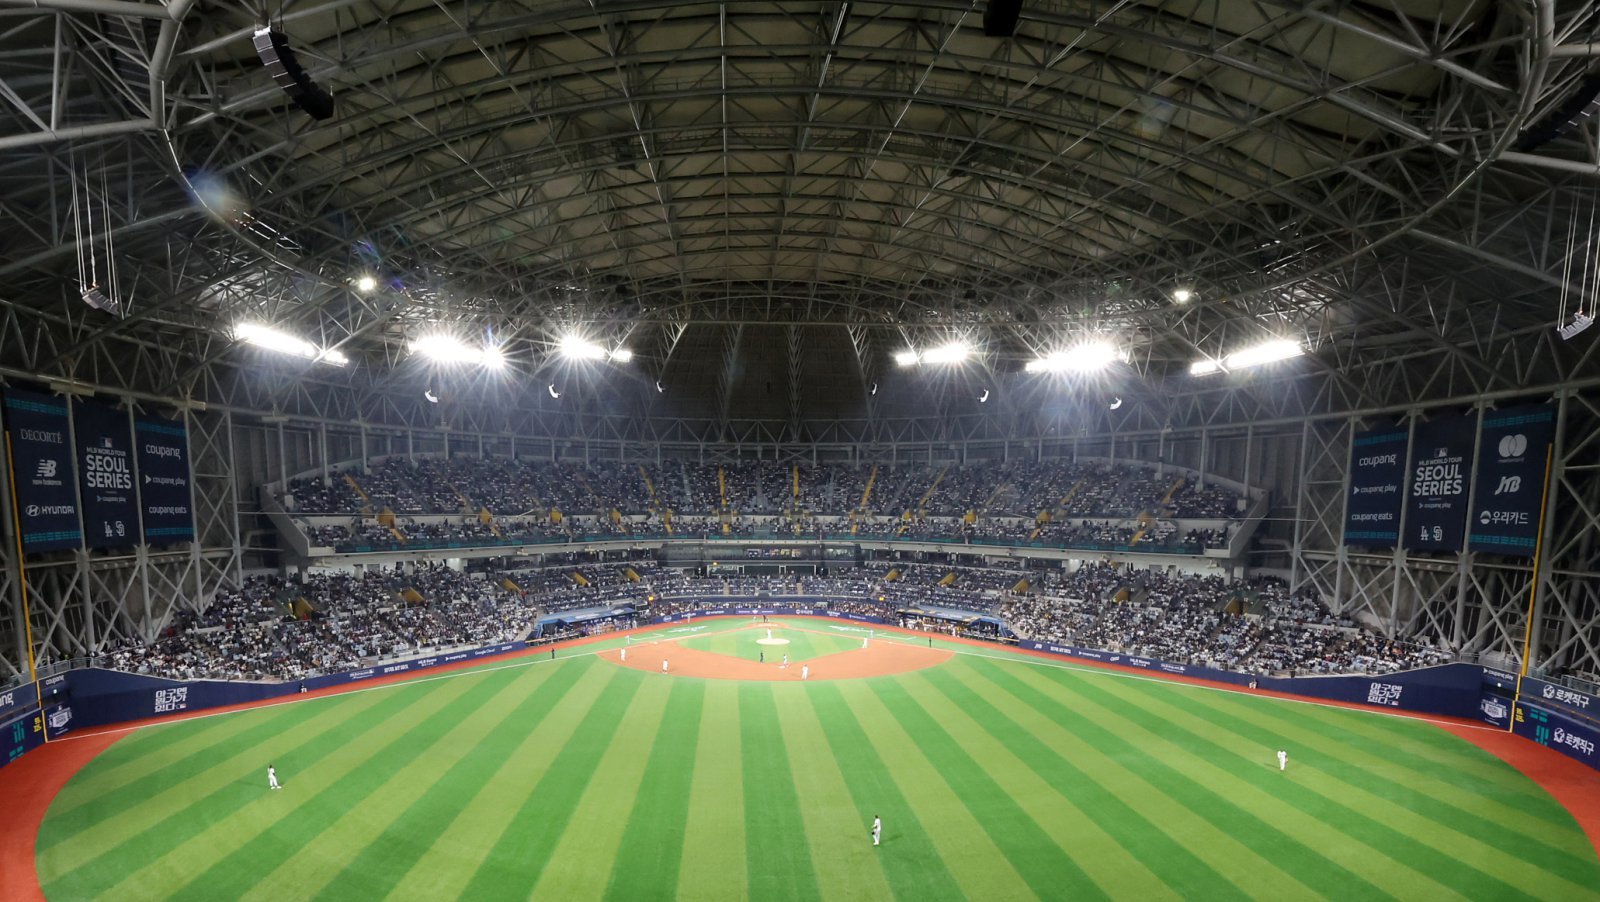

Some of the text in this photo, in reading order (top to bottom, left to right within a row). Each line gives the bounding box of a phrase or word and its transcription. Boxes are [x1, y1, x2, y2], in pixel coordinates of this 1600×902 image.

[20, 428, 63, 444] DECORTÉ
[98, 448, 114, 456] WORLD
[146, 444, 181, 460] coupang
[86, 454, 129, 473] SEOUL
[1359, 454, 1396, 468] coupang
[86, 471, 132, 489] SERIES
[1416, 464, 1462, 482] SEOUL
[1360, 484, 1397, 494] coupang play
[1413, 479, 1462, 496] SERIES
[42, 505, 75, 514] HYUNDAI
[149, 506, 187, 515] coupang eats
[1351, 512, 1393, 522] coupang eats
[1491, 511, 1529, 525] 우리카드
[1555, 689, 1590, 708] 로켓직구
[1564, 733, 1595, 756] 로켓직구
